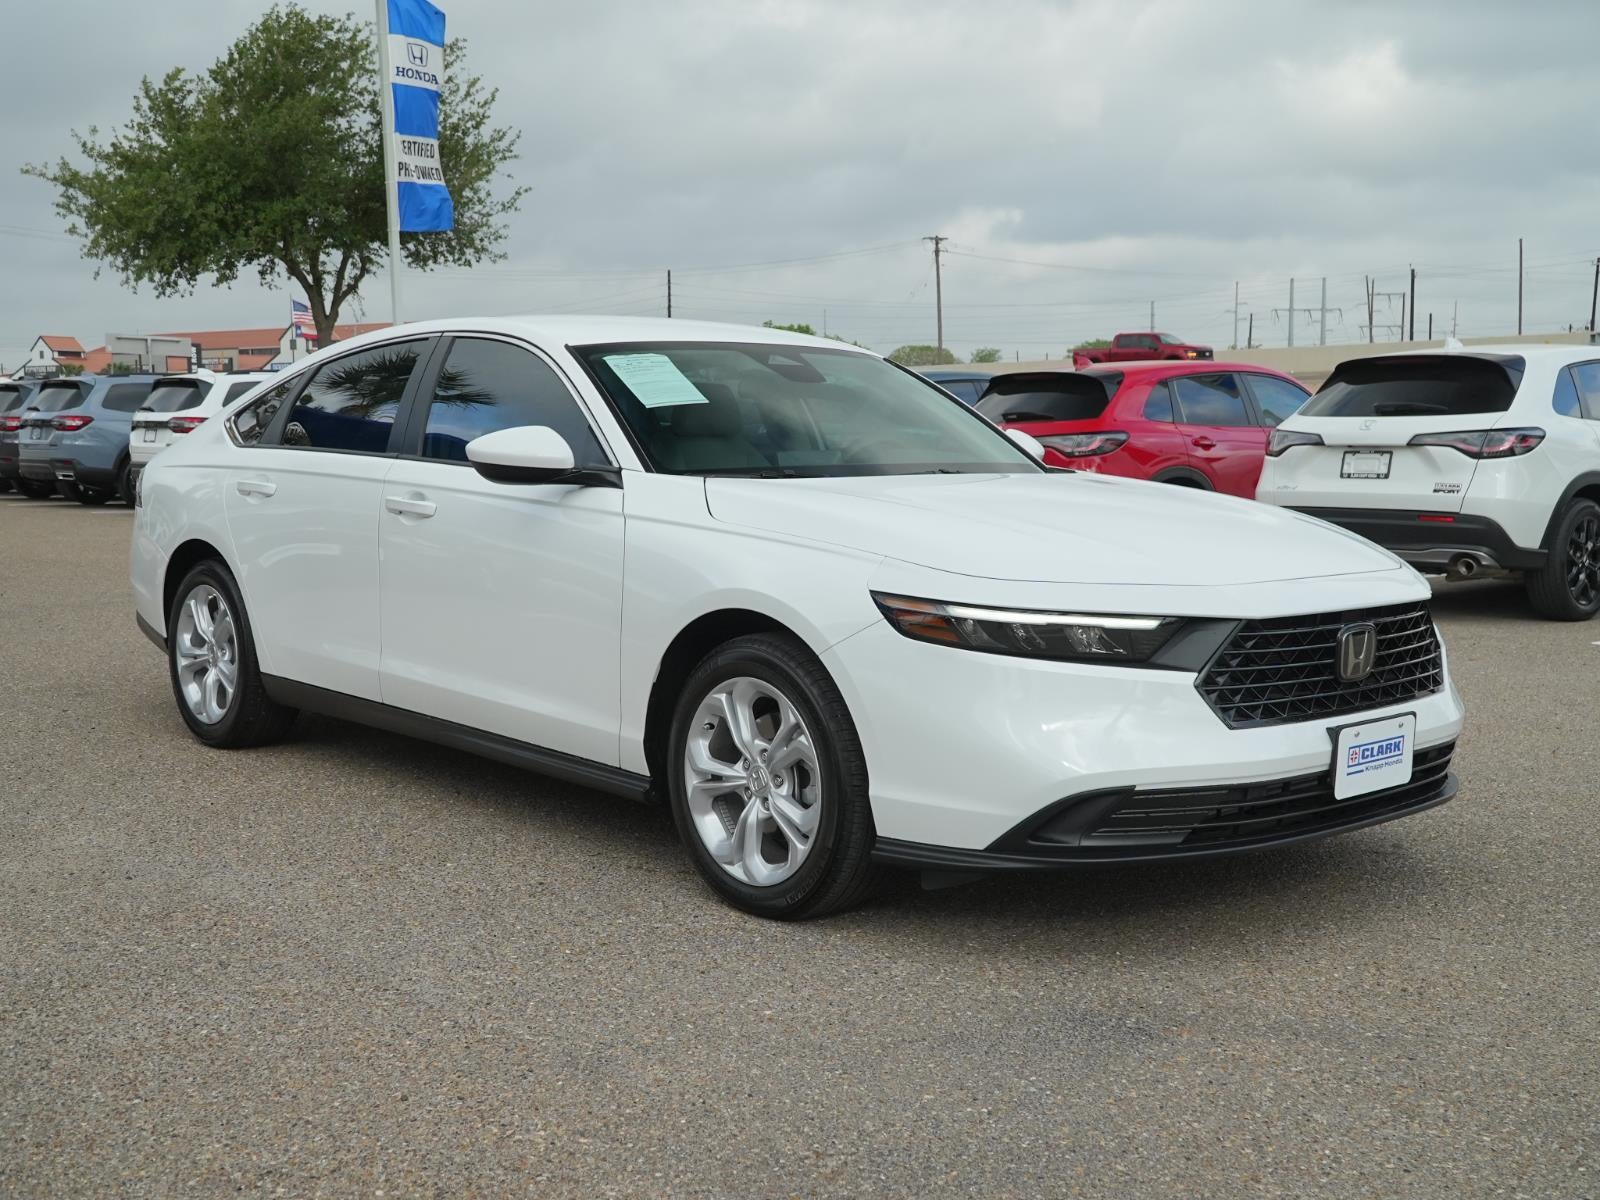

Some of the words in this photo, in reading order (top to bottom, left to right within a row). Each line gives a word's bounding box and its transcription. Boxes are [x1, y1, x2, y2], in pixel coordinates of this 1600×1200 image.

[395, 66, 439, 85] HONDA
[401, 140, 435, 159] ERTIFIED
[1361, 740, 1402, 761] CLARK
